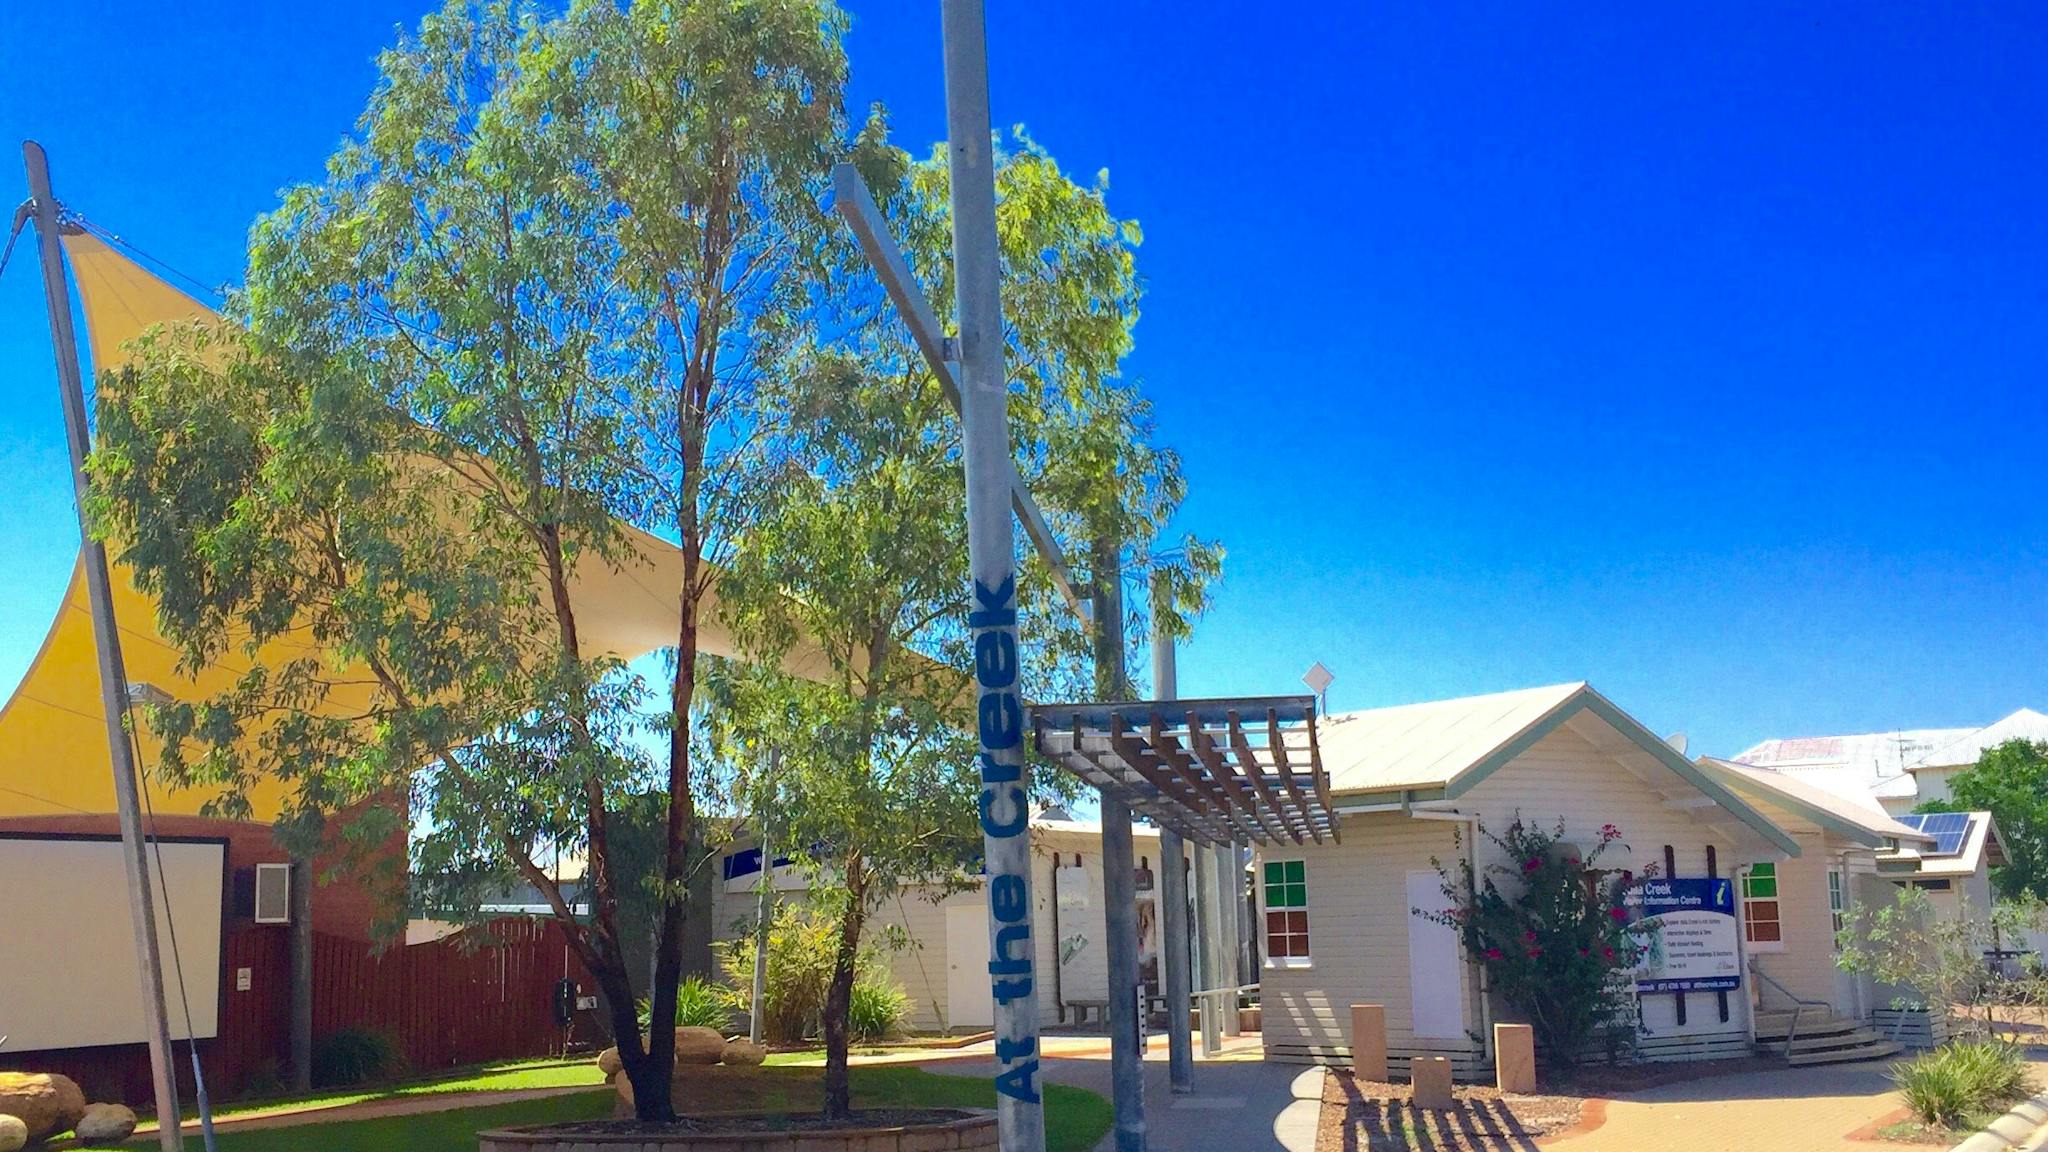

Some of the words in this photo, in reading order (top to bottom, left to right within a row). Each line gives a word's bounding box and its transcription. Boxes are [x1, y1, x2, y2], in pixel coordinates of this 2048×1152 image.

[1644, 897, 1679, 906] Information
[1680, 896, 1701, 905] Centre
[1645, 883, 1671, 895] Creek
[988, 874, 1032, 1006] the
[994, 1036, 1040, 1104] At
